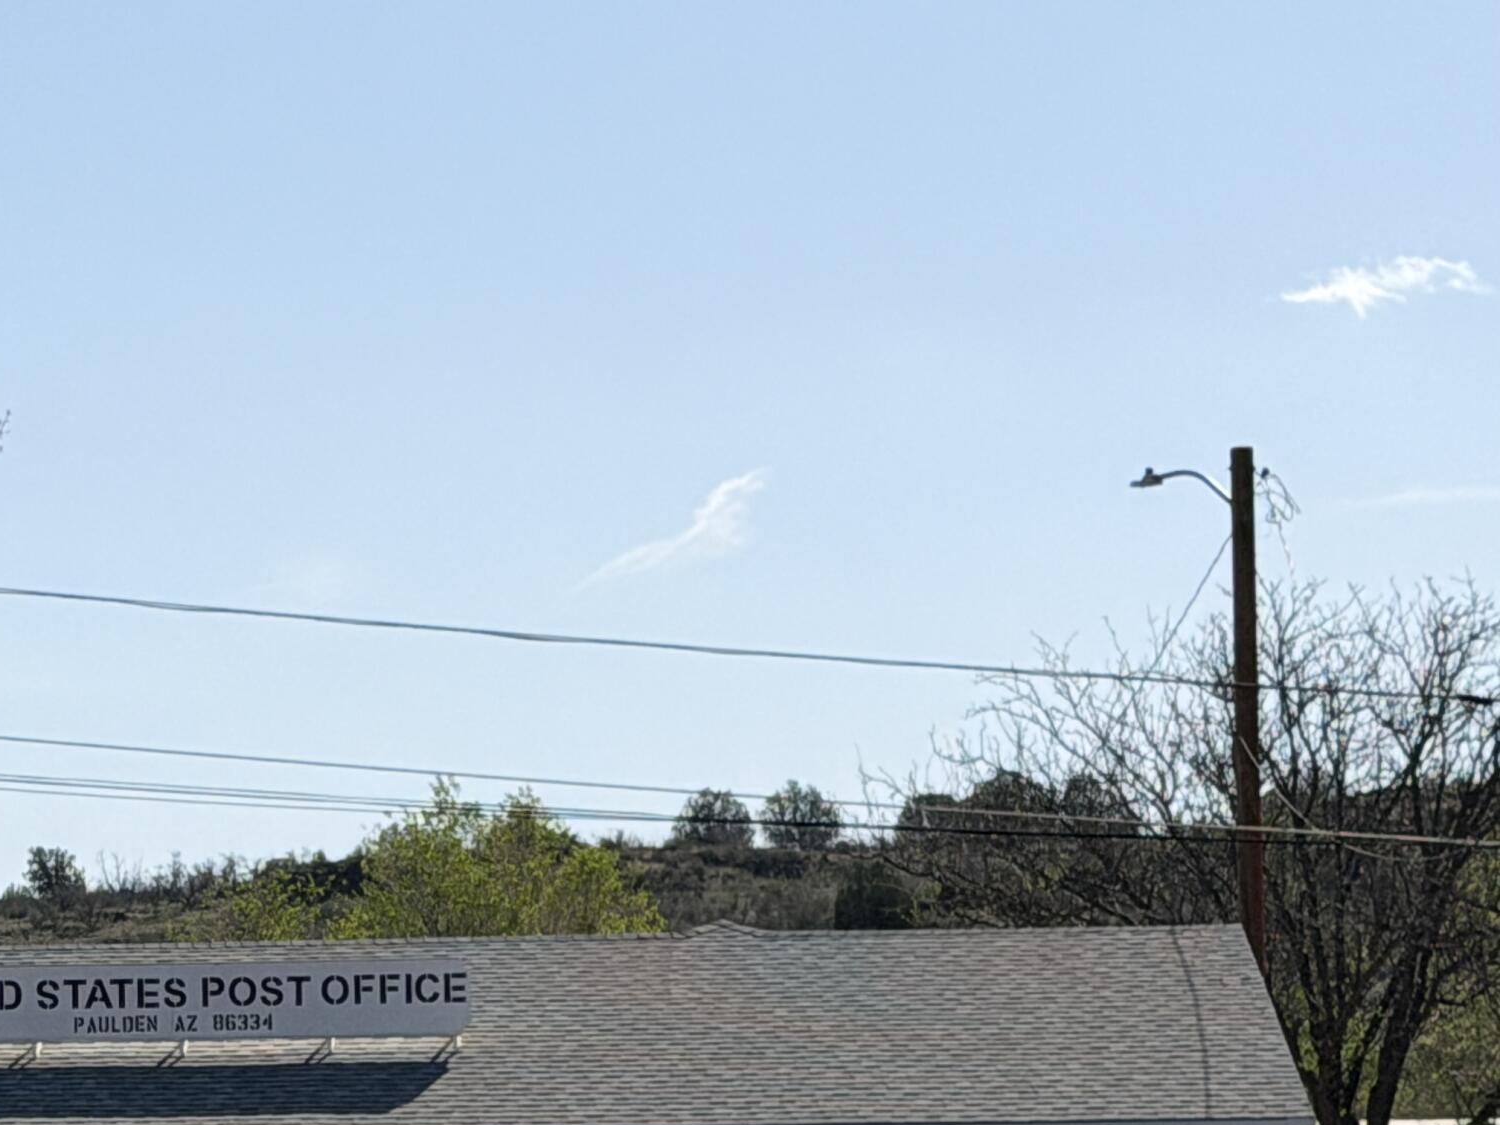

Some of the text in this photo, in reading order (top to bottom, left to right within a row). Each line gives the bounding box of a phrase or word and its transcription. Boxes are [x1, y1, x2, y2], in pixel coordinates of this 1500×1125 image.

[37, 977, 187, 1010] STATES
[201, 975, 312, 1008] POST
[321, 972, 467, 1006] OFFICE
[73, 1013, 273, 1033] PAULDEN AZ 86334
